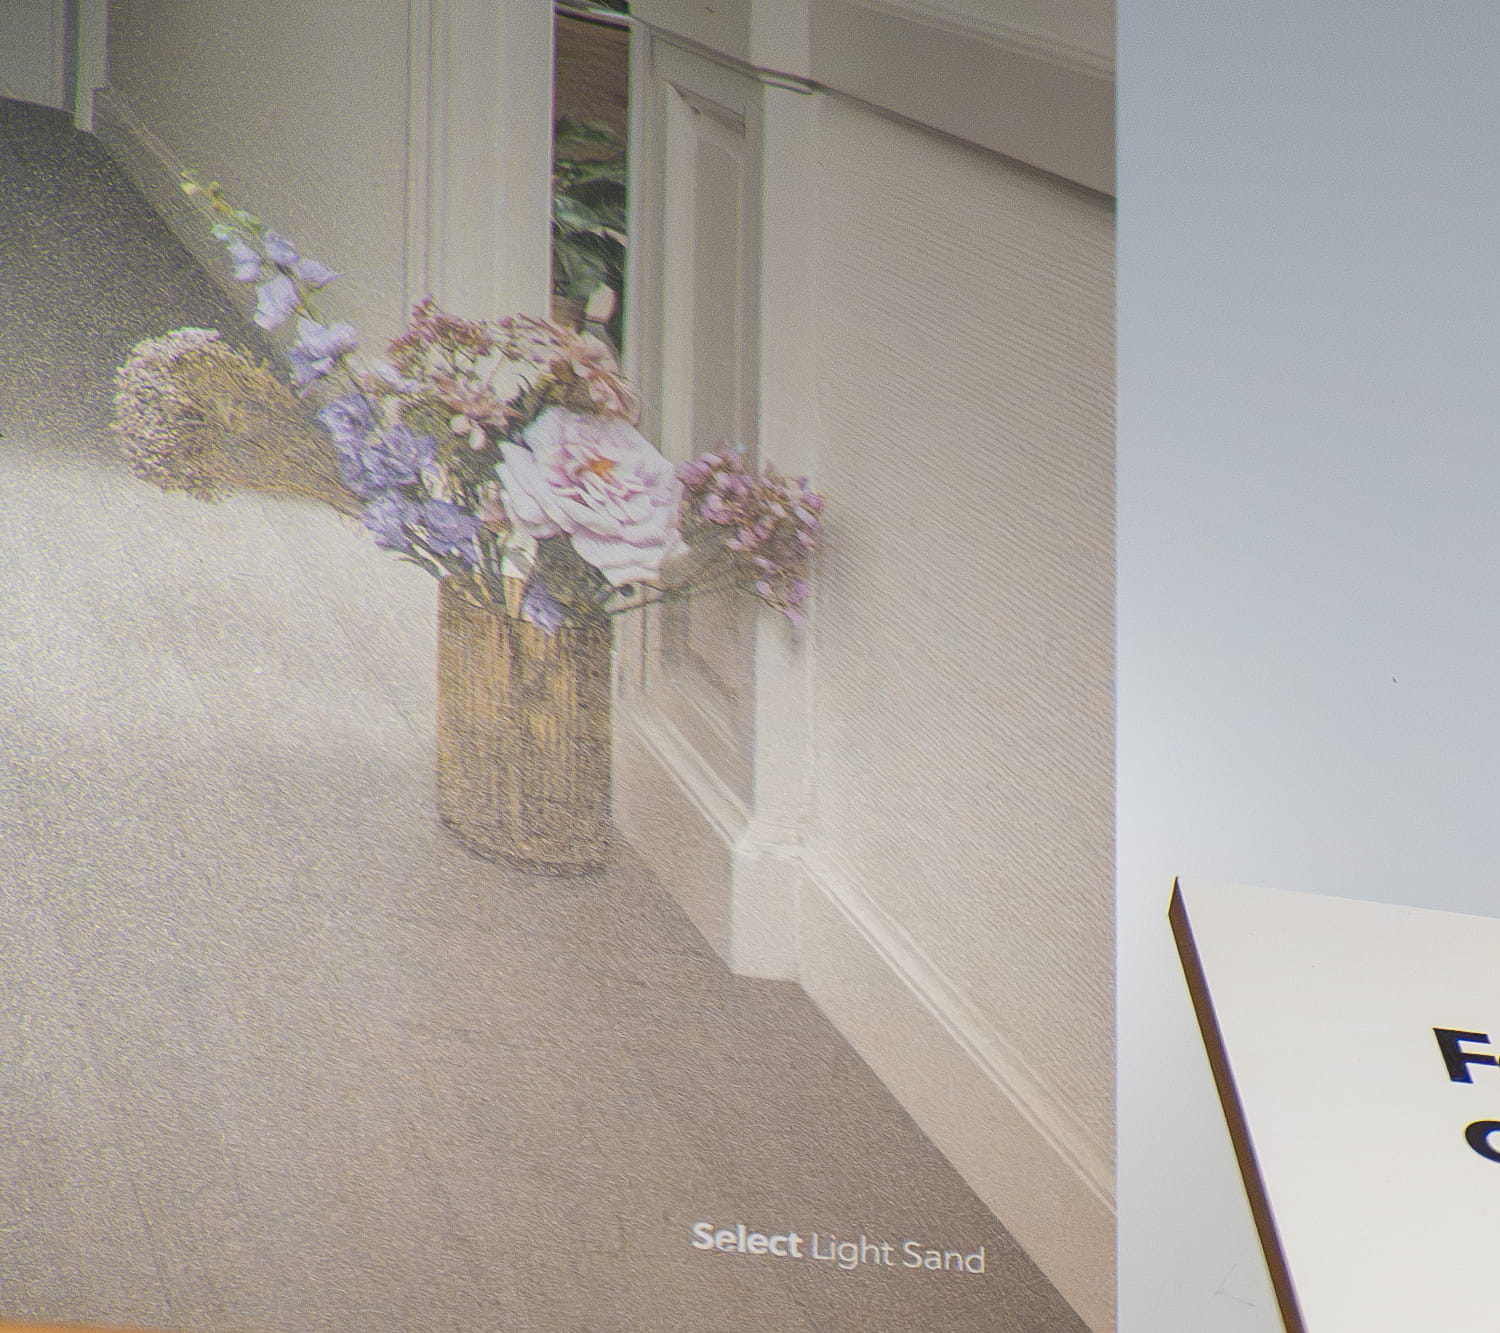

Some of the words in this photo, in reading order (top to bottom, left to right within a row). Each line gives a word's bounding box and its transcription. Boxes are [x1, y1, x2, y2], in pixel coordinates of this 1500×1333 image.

[692, 1221, 803, 1259] Select
[810, 1232, 895, 1270] Light
[902, 1241, 987, 1275] Sand
